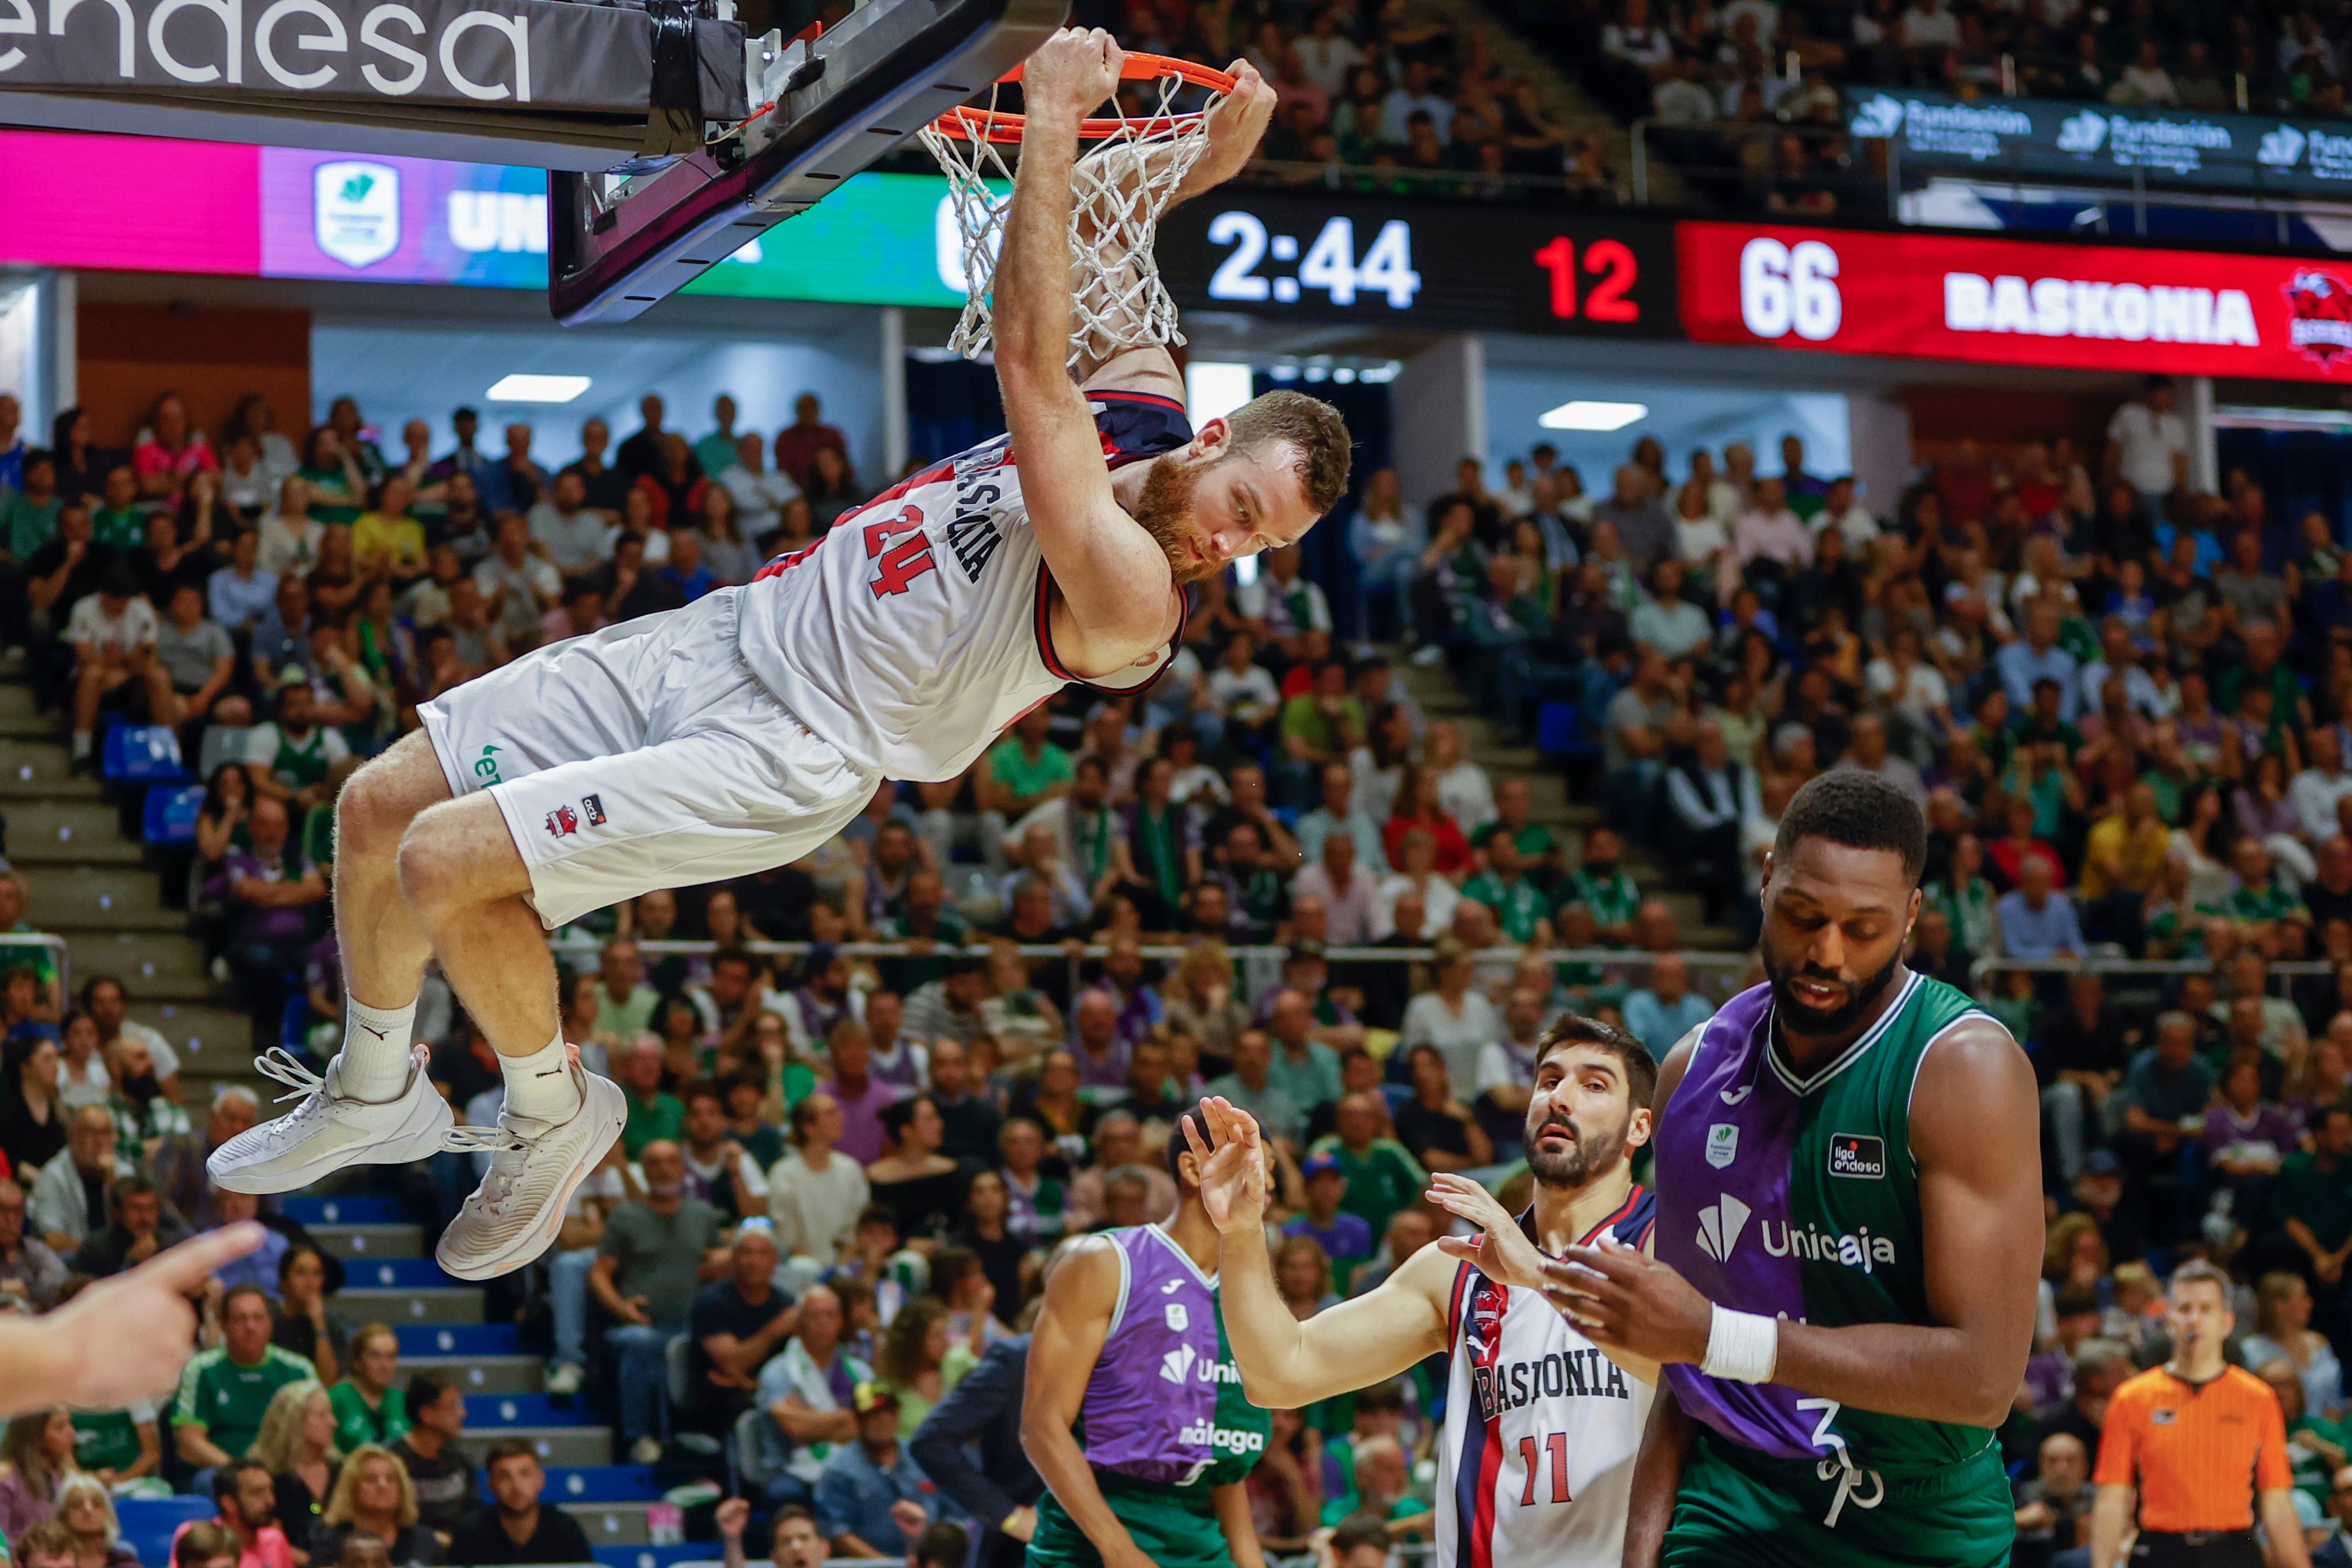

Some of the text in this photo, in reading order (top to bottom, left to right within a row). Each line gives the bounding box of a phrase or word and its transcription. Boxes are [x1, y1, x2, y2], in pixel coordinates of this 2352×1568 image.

[1207, 210, 1422, 309] 2:44
[1533, 236, 1640, 323] 12
[1740, 237, 1842, 340] 66
[1944, 272, 2260, 347] BASKONIA
[863, 504, 937, 601] 24
[584, 799, 597, 820] acb
[1834, 1159, 1881, 1173] endesa
[1835, 1146, 1855, 1161] liga
[1761, 1219, 1896, 1274] Unicaja
[1520, 1432, 1573, 1507] 11
